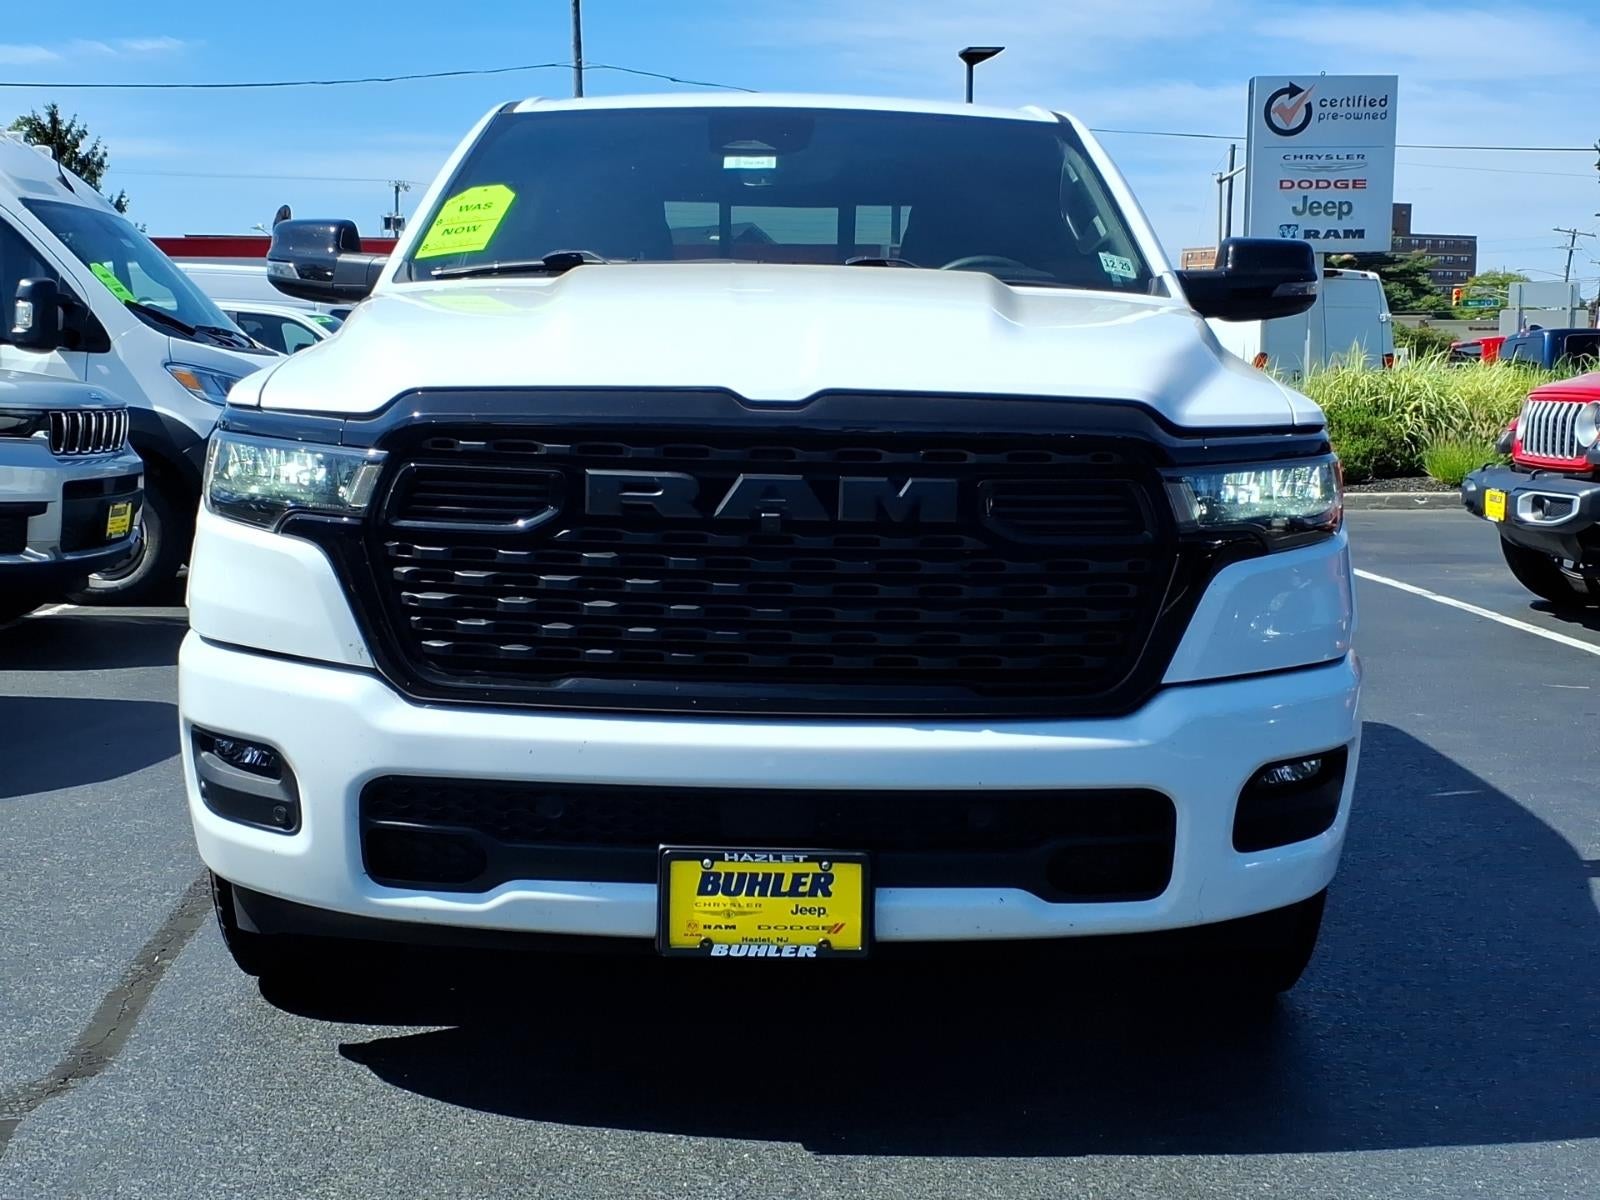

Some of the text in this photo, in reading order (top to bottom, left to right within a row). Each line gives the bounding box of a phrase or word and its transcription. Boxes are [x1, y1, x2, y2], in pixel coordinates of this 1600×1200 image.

[1319, 95, 1388, 108] certified
[1318, 111, 1388, 123] pre-owned
[1282, 153, 1366, 161] CHRYSLER
[1279, 179, 1367, 190] DODGE
[459, 202, 493, 213] WAS
[1291, 195, 1353, 220] Jeep
[441, 224, 482, 236] NOW
[1303, 229, 1365, 240] RAM
[1103, 258, 1117, 269] 12
[585, 469, 958, 522] RAM
[724, 852, 808, 863] HAZLET
[696, 871, 835, 898] BUHLER
[790, 904, 827, 917] Jeep
[710, 944, 817, 958] BUHLER
